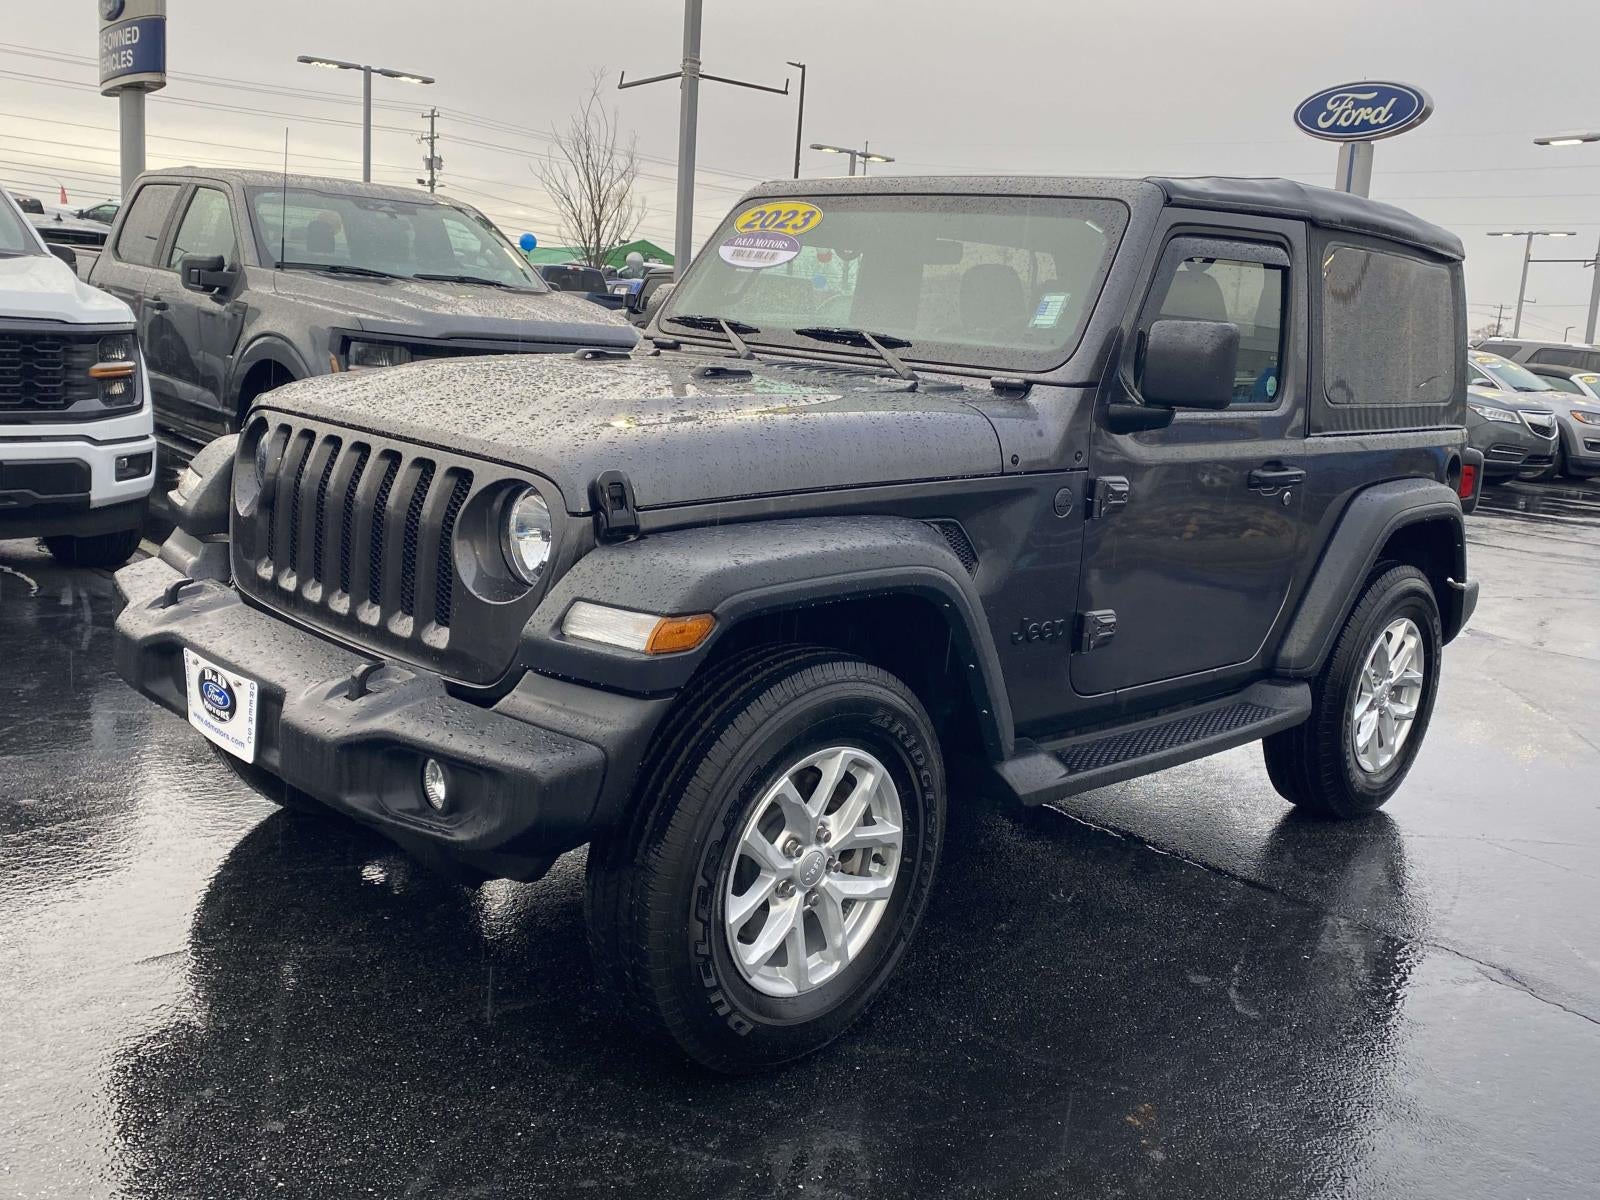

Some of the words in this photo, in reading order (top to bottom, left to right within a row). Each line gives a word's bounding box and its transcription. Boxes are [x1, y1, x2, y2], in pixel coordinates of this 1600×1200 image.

[101, 49, 133, 74] EHICLES
[1317, 91, 1398, 128] Ford
[742, 210, 816, 230] 2023
[754, 238, 790, 250] MOTORS
[1010, 617, 1065, 646] Jeep
[204, 668, 227, 690] D&D
[207, 684, 226, 707] Ford
[203, 697, 230, 721] MOTORS
